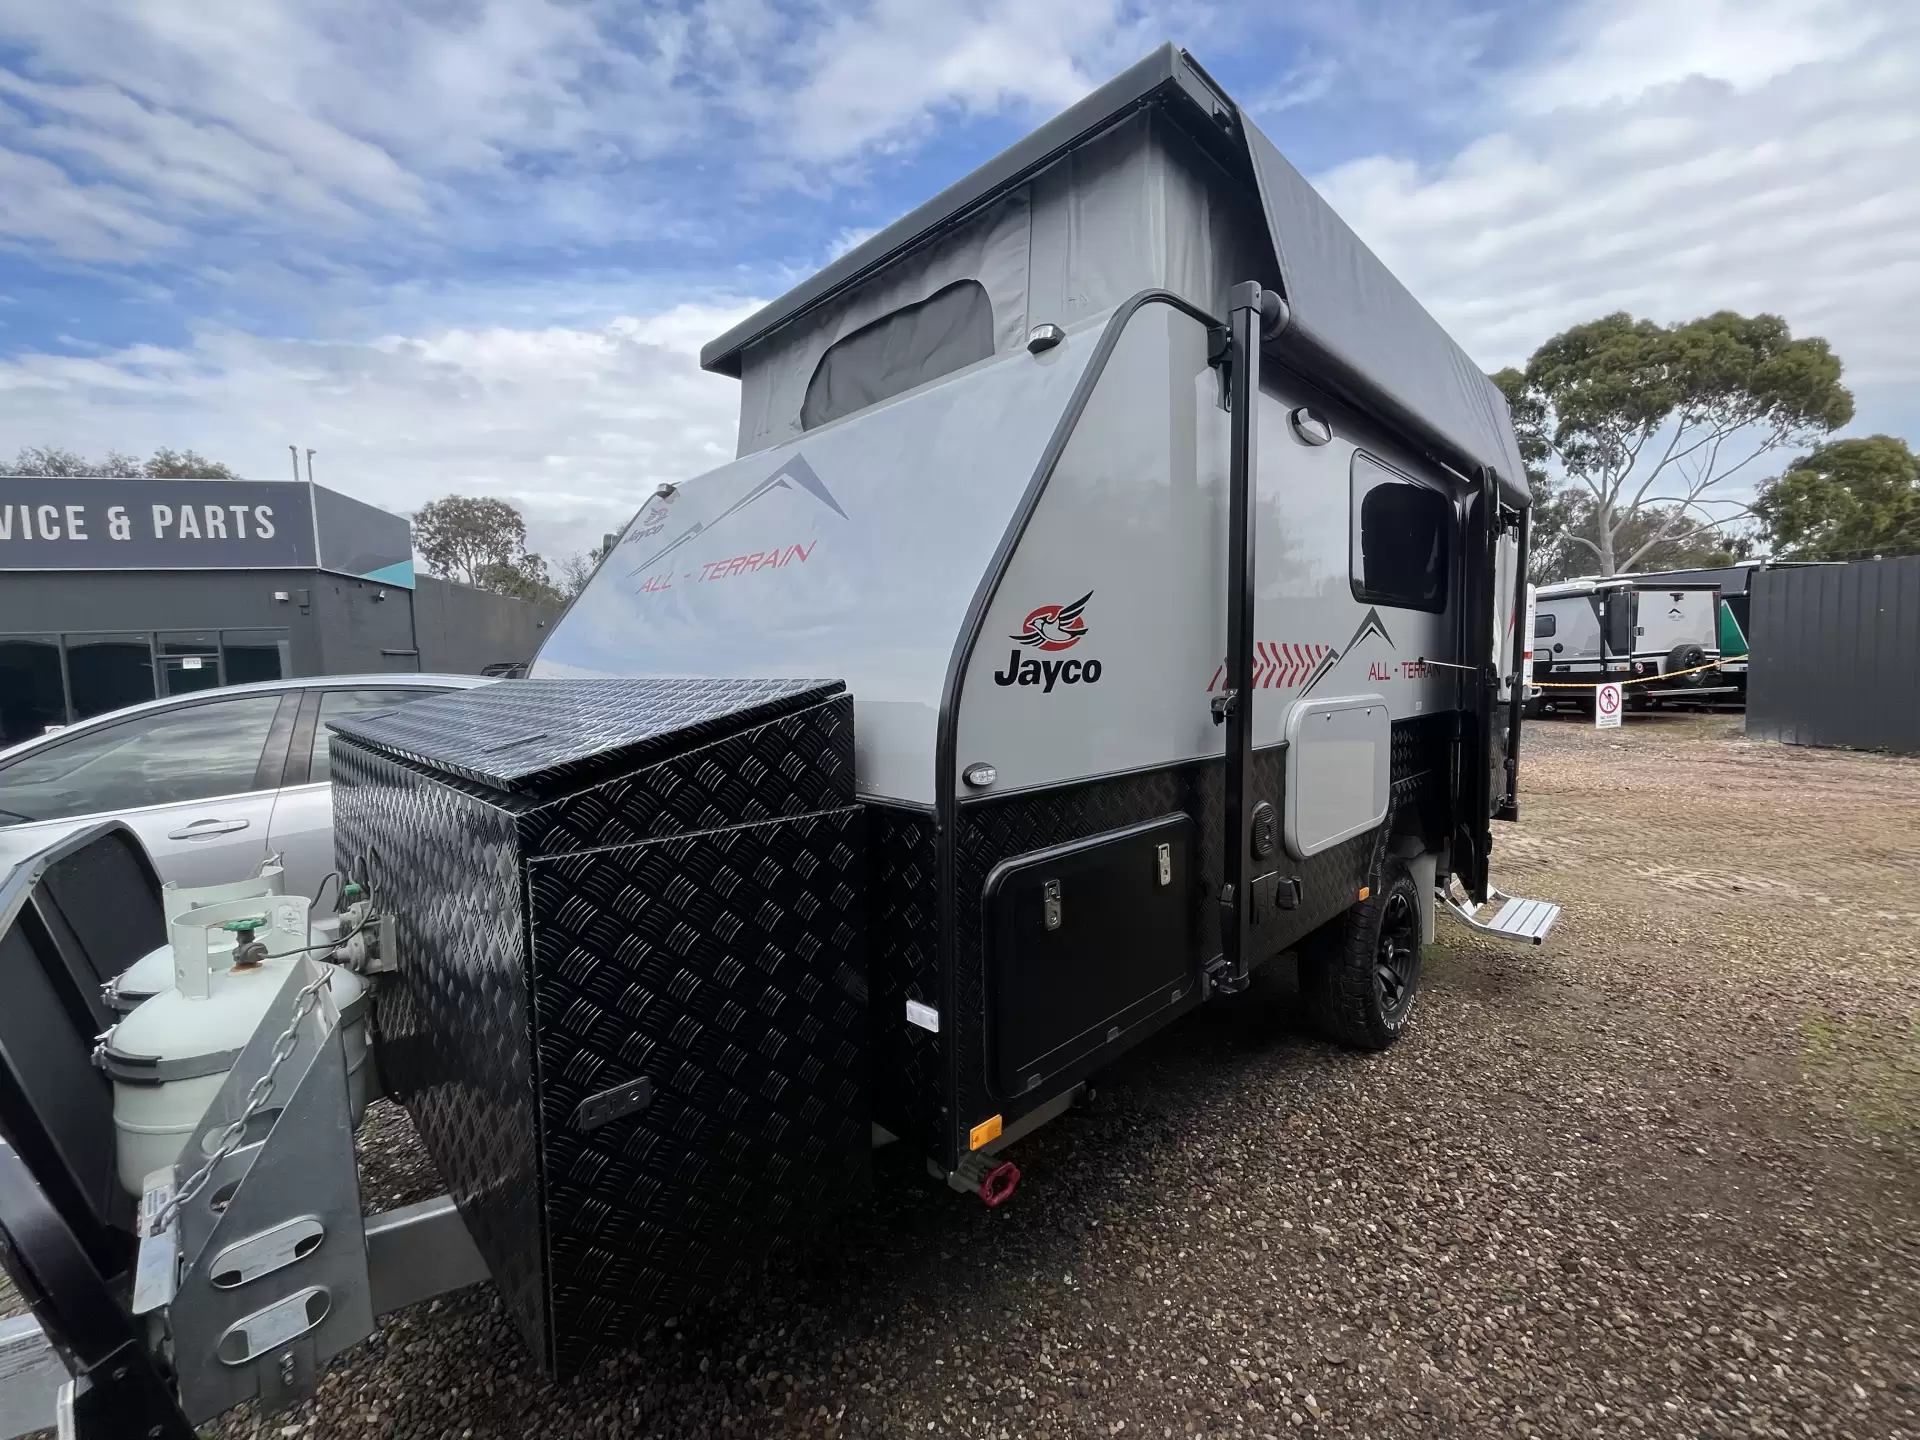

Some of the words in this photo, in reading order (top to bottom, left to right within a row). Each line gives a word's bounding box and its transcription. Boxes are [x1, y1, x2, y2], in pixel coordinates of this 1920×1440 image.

[107, 506, 131, 540] &
[152, 505, 275, 539] PARTS
[635, 572, 674, 595] ALL
[697, 540, 818, 583] TERRAIN
[994, 649, 1102, 694] Jayco
[1368, 661, 1390, 681] ALL
[1401, 661, 1440, 679] TERRAIN
